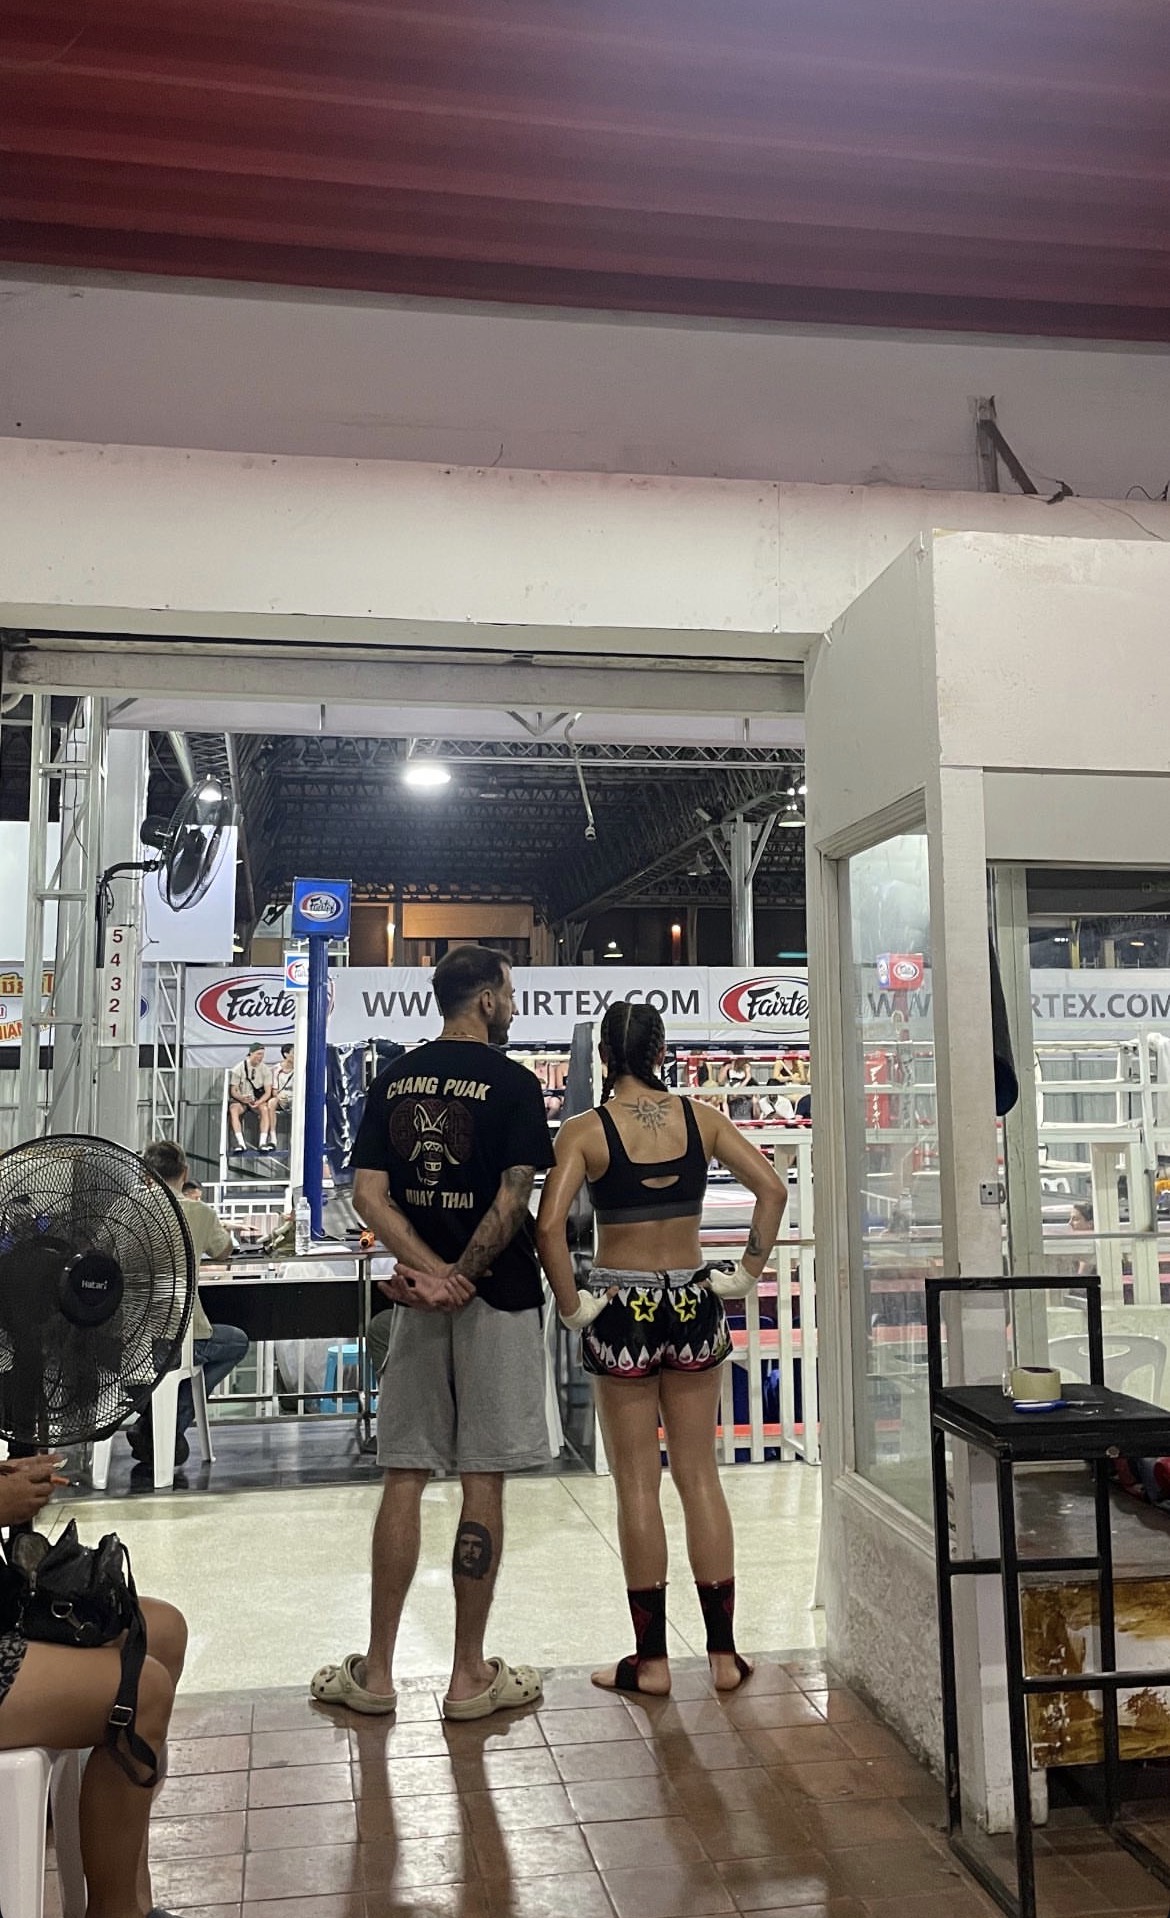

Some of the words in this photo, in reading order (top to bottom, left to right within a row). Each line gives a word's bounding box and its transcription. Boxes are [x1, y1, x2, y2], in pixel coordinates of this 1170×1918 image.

[113, 929, 123, 943] 5
[110, 953, 120, 967] 4
[110, 977, 121, 991] 3
[108, 998, 120, 1012] 2
[226, 984, 296, 1021] Fairte
[747, 985, 809, 1020] Fairte
[109, 1023, 117, 1037] 1
[386, 1076, 439, 1100] CHANG
[443, 1078, 492, 1101] PUAK
[441, 1191, 474, 1209] THAI
